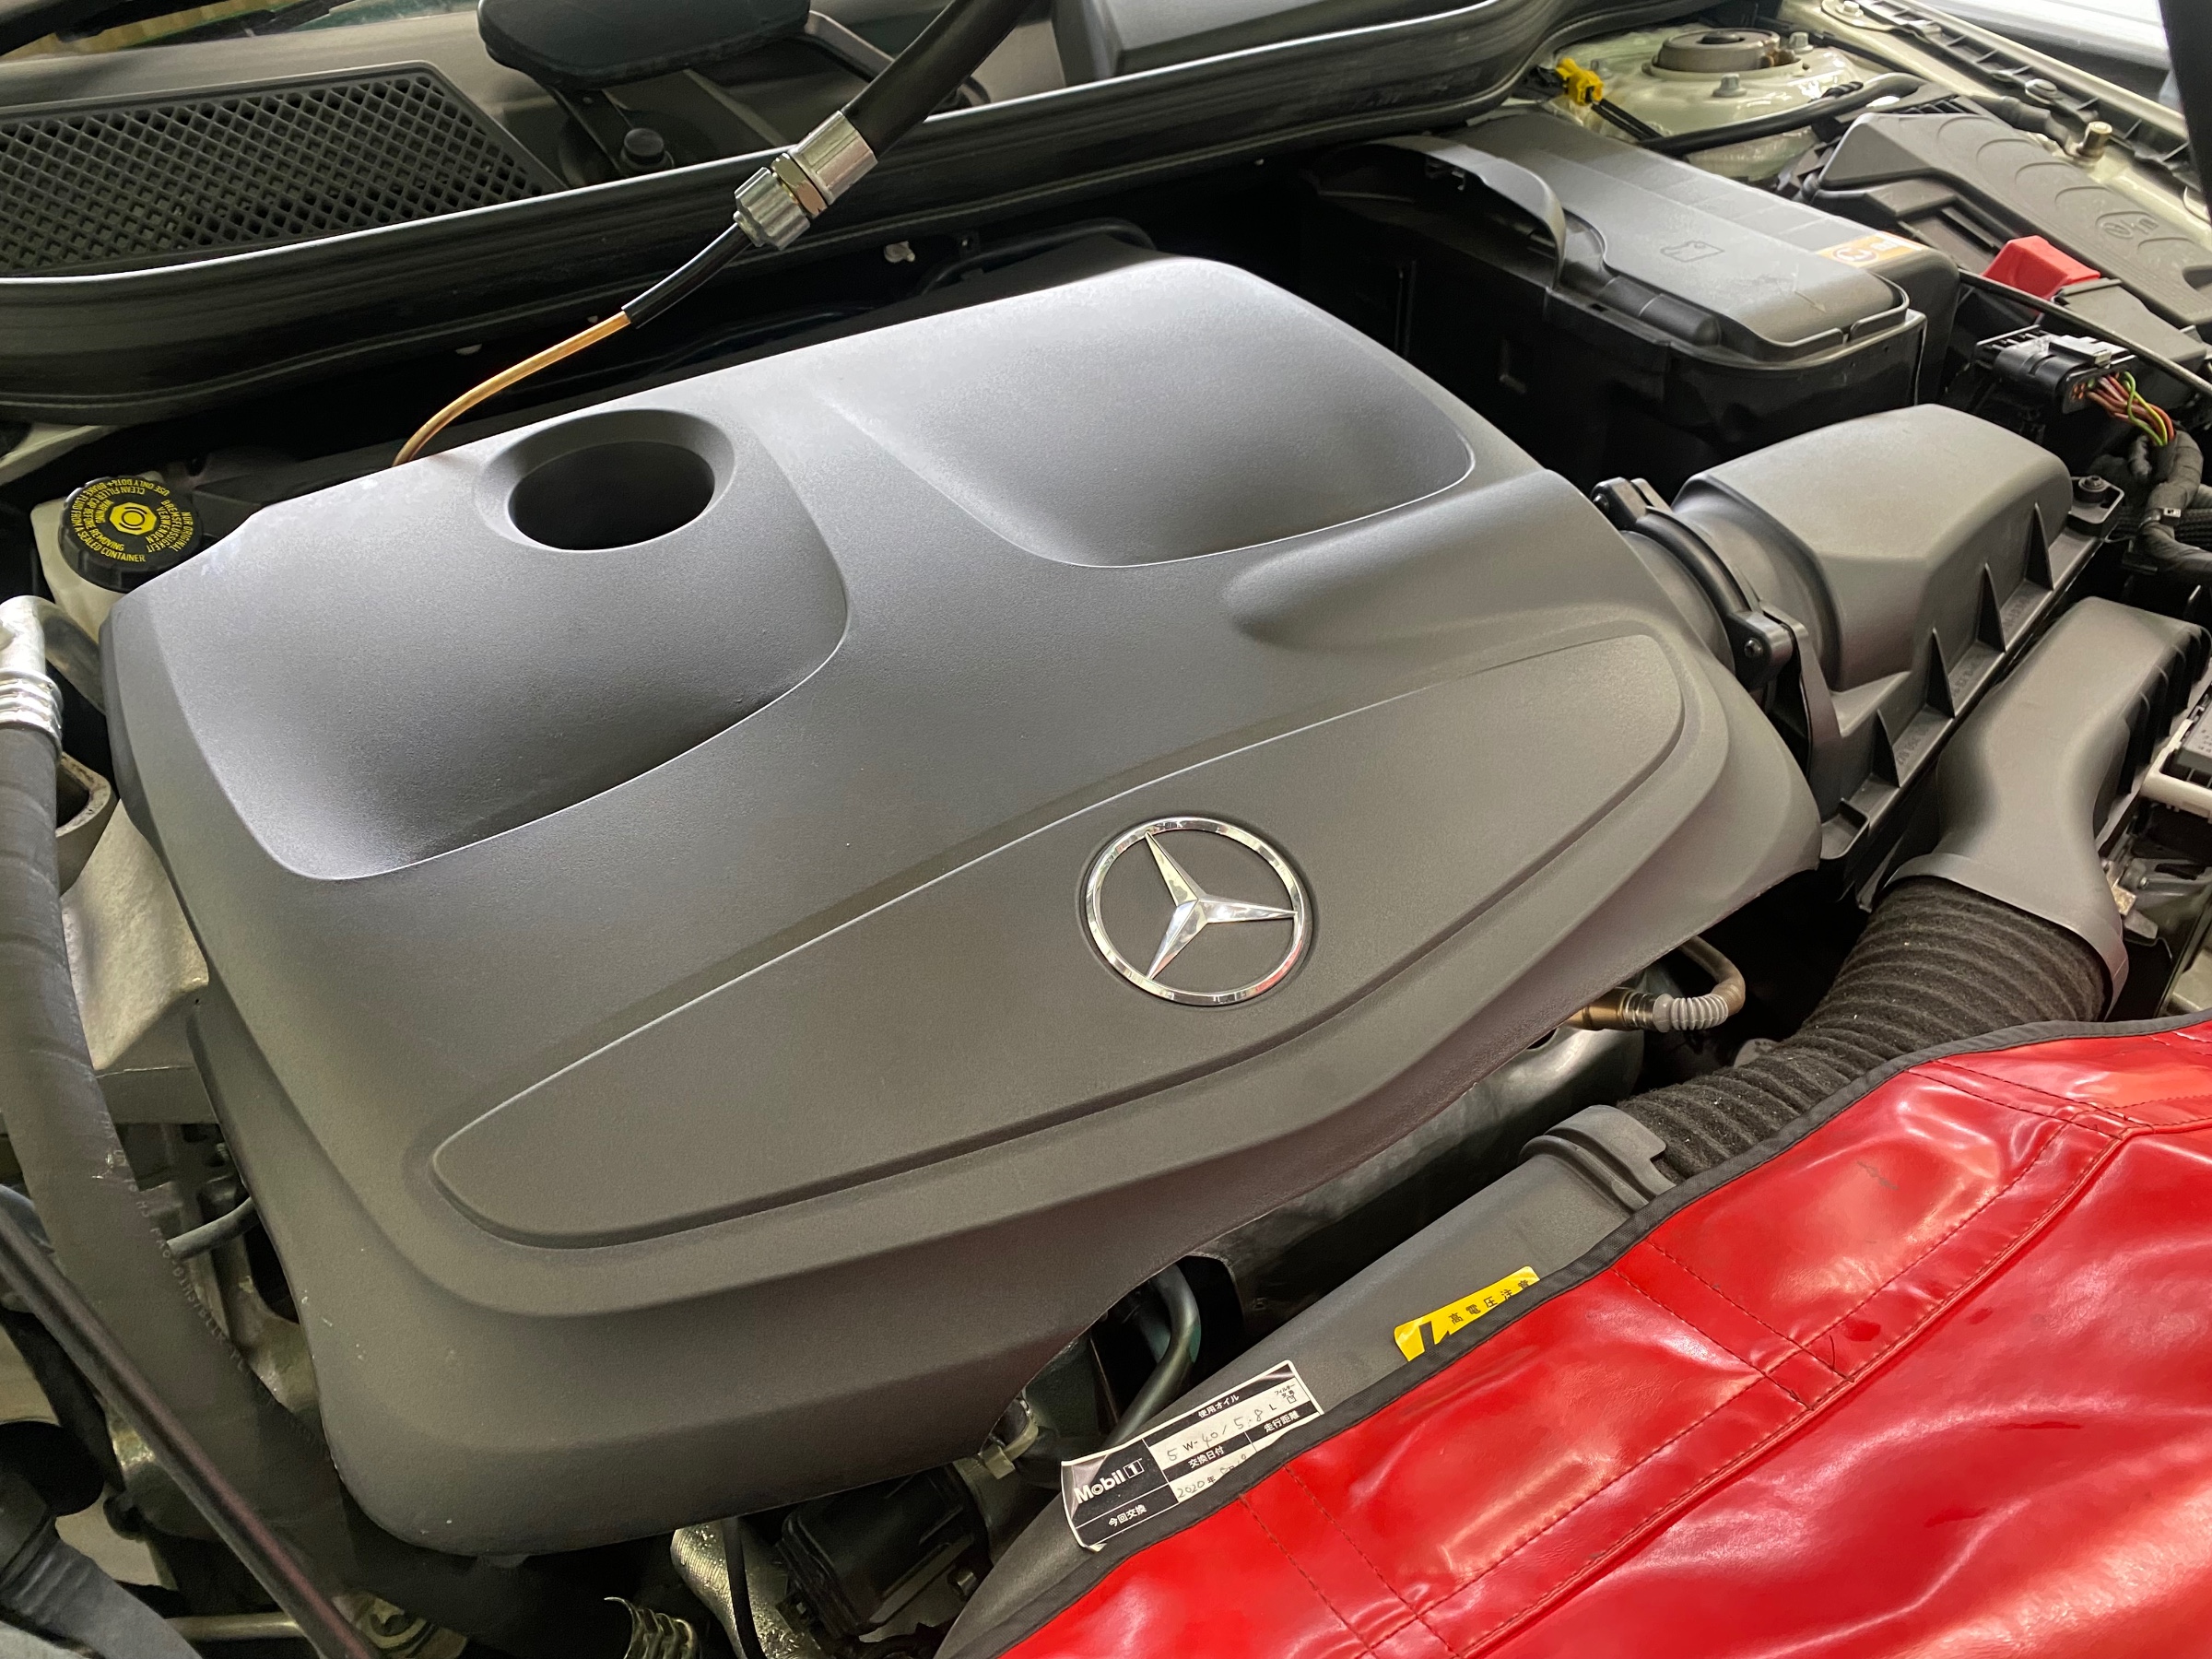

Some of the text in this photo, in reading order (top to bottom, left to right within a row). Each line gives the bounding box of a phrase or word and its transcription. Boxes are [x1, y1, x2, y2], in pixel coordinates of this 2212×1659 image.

[82, 482, 107, 498] BRAKE
[134, 479, 155, 489] ONLY
[153, 485, 171, 497] USE
[72, 494, 89, 510] FLUID
[95, 499, 114, 524] WARNING
[70, 510, 84, 526] FROM
[83, 486, 146, 551] CLEAN FILLER CAP BEFORE REMOVING
[145, 506, 171, 544] VERWENDEN
[76, 530, 103, 551] SEALED
[169, 512, 194, 552] NUR ORIGINAL
[100, 547, 147, 563] CONTAINER
[1198, 1394, 1240, 1418] 使用オイル
[1264, 1410, 1300, 1433] 走行距離
[1188, 1445, 1225, 1469] 交換日付
[1073, 1469, 1126, 1504] Mobil
[1108, 1503, 1147, 1527] 今回交換
